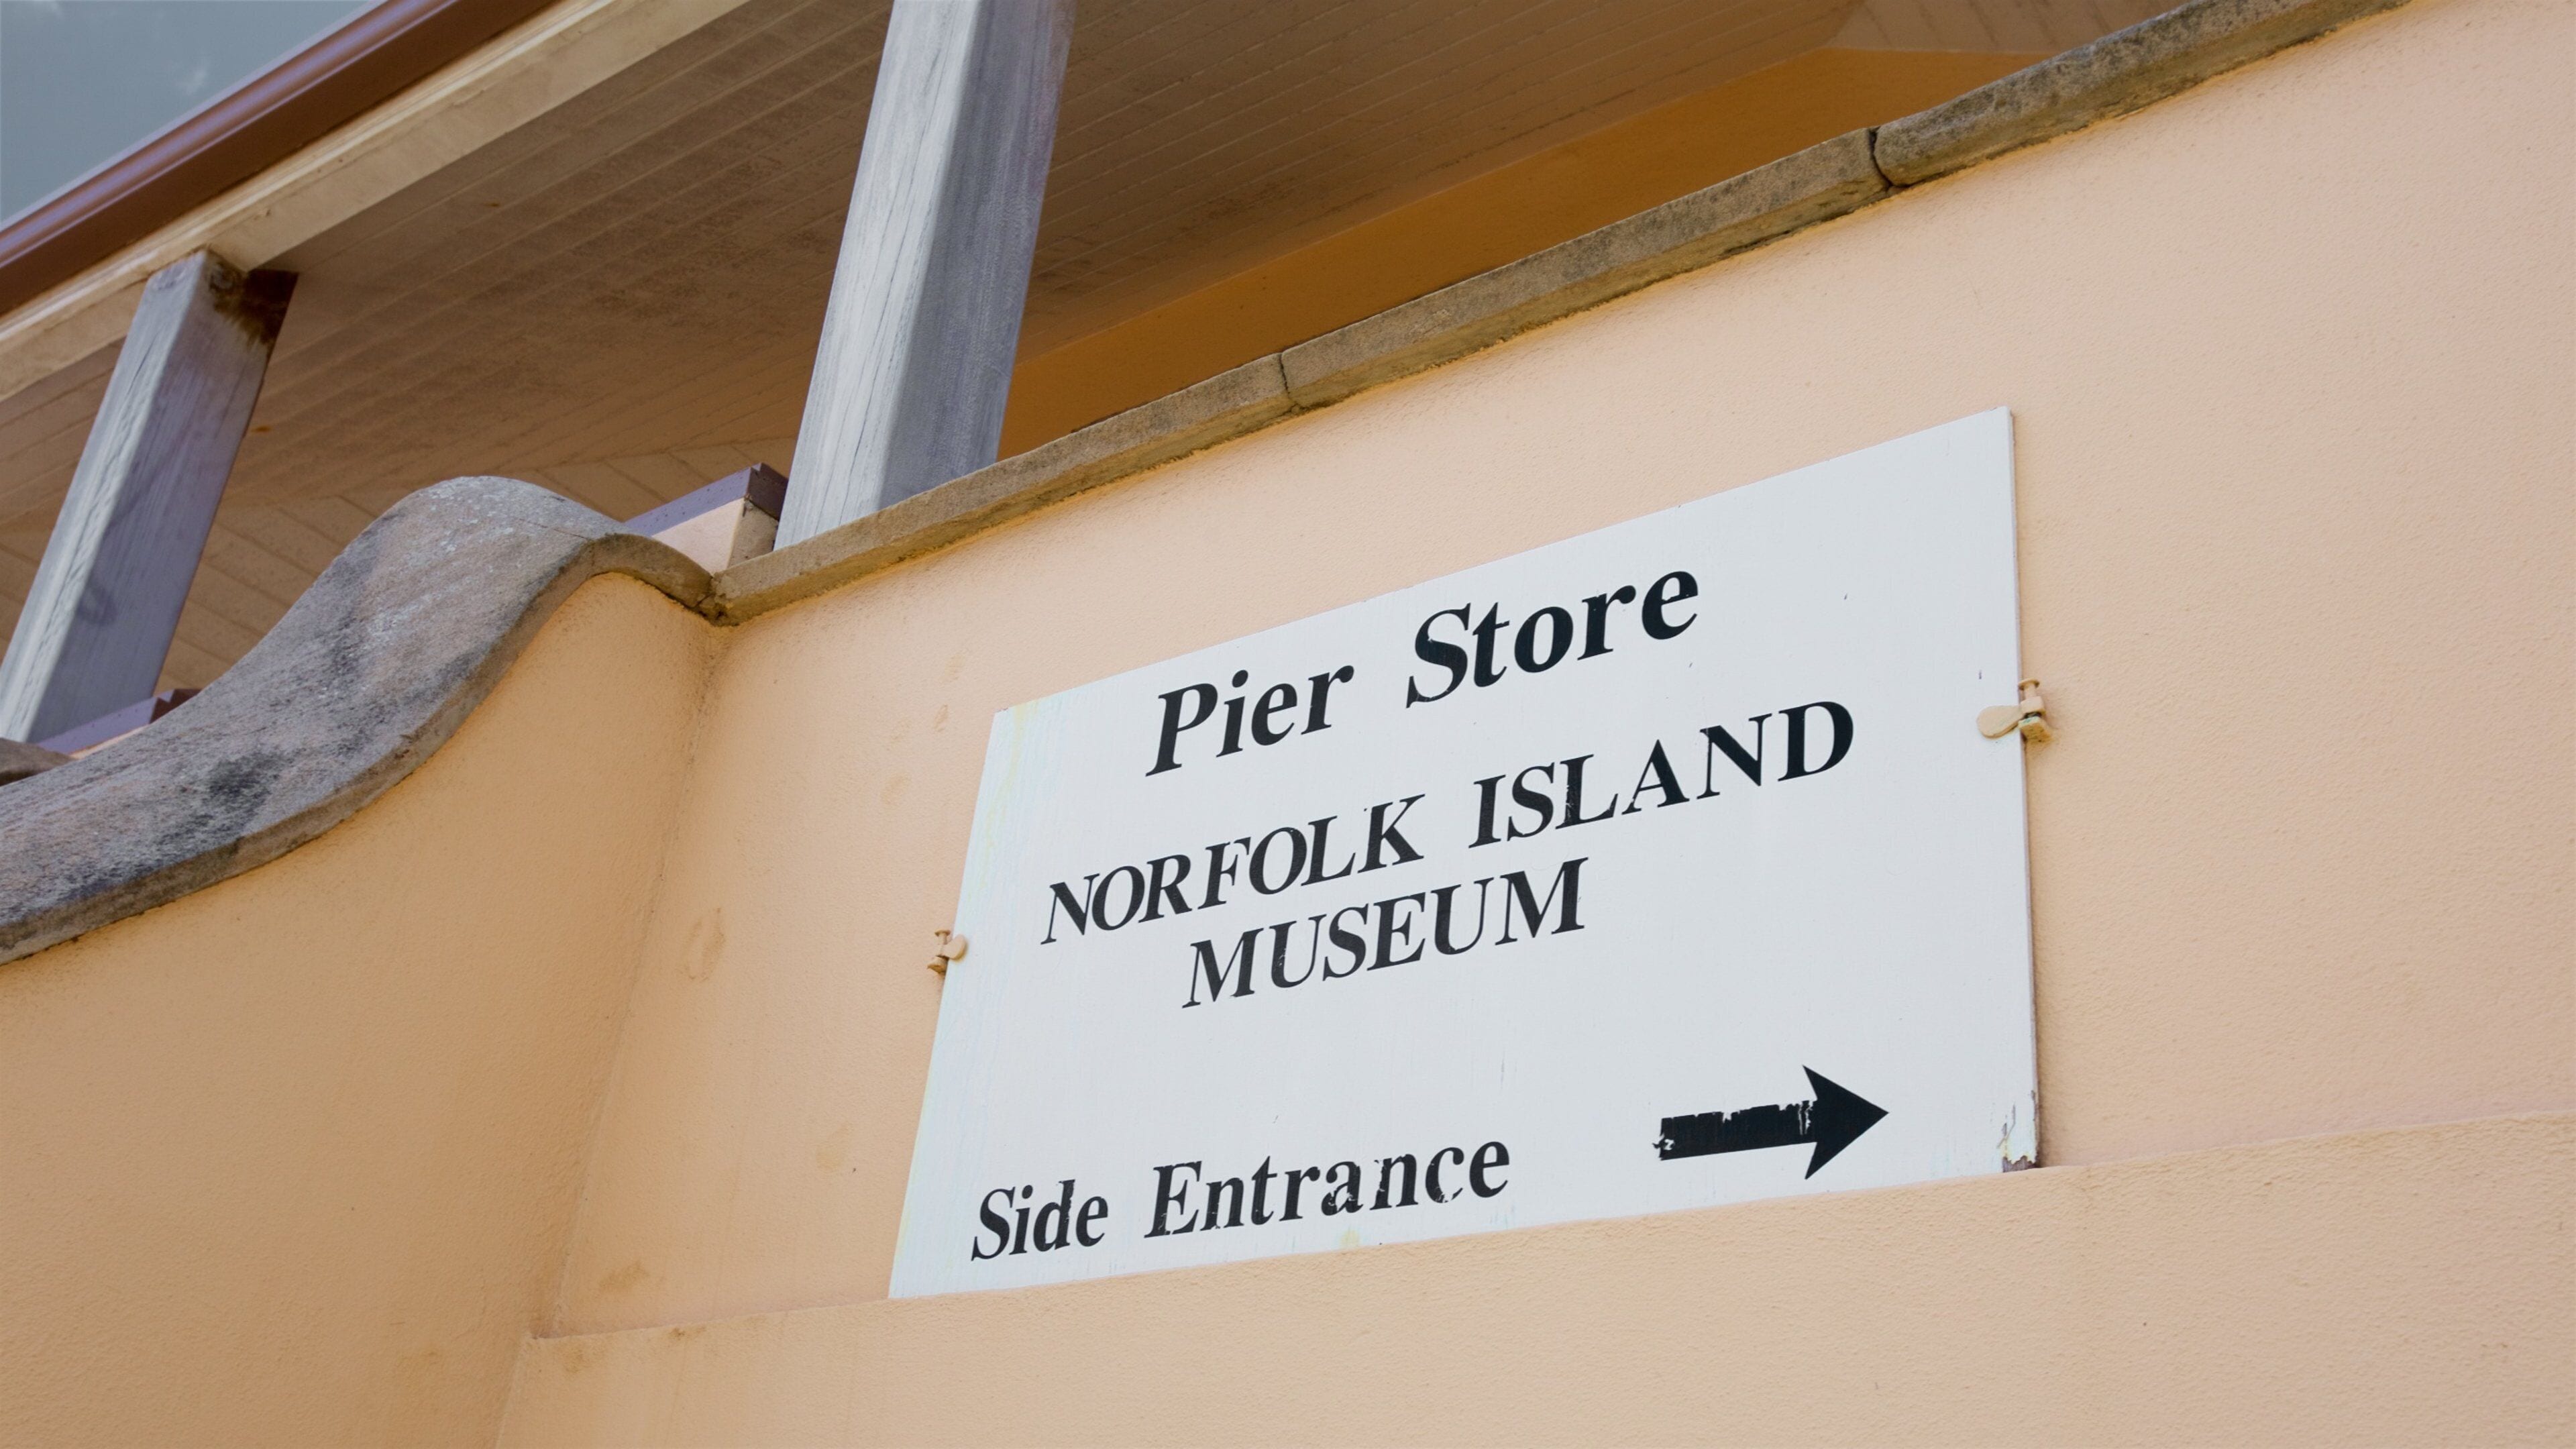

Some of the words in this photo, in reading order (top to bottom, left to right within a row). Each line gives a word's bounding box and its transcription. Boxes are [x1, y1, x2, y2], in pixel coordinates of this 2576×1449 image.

[1145, 669, 1354, 777] Pier
[1405, 571, 1699, 708] Store
[1040, 794, 1426, 945] NORFOLK
[1468, 701, 1854, 849] ISLAND
[1182, 857, 1589, 1008] MUSEUM
[971, 1179, 1109, 1261] Side
[1144, 1141, 1510, 1238] Entrance
